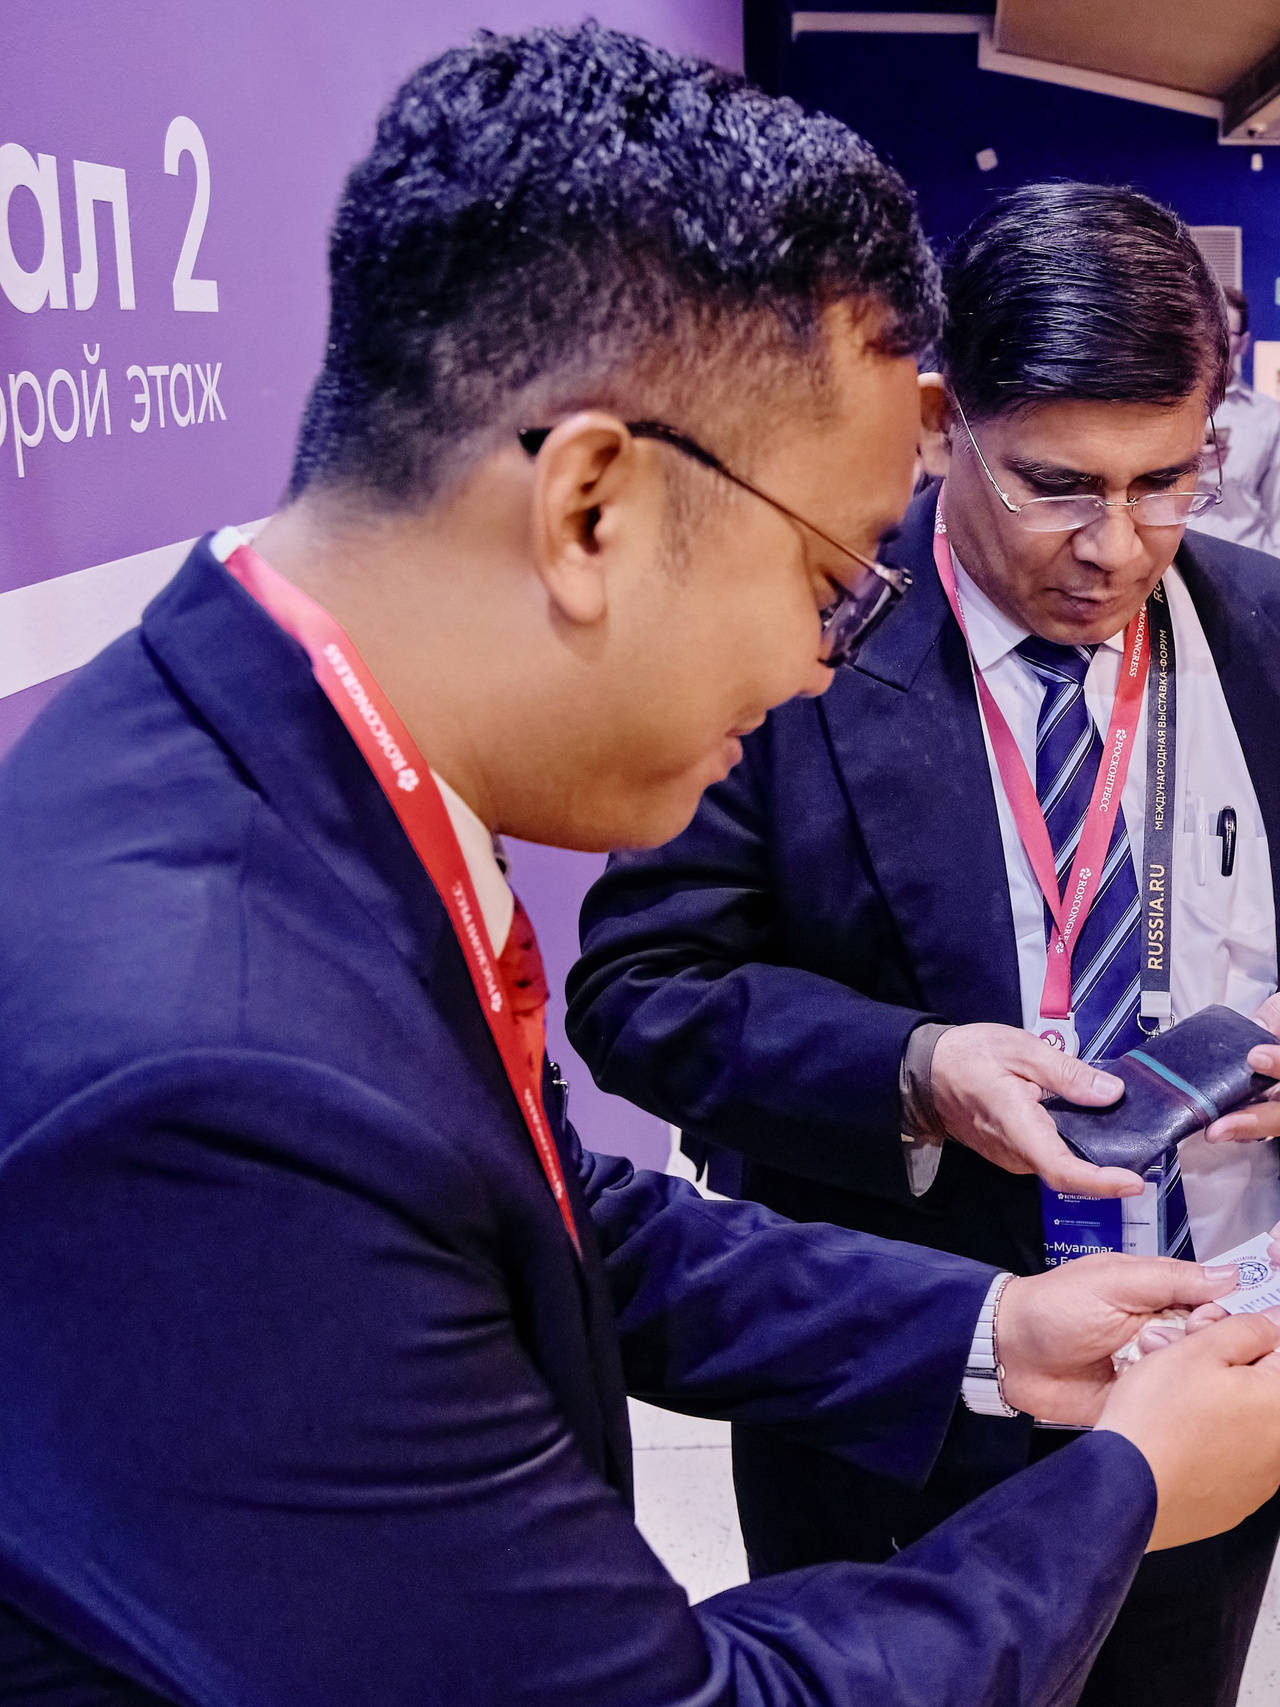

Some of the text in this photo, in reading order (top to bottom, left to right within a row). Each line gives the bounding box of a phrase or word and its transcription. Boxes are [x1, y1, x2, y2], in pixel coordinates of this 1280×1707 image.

[0, 115, 219, 314] ал 2
[126, 362, 227, 433] этаж
[1129, 610, 1146, 678] ROSCONGRESS
[322, 643, 406, 773] ROSCONGRESS
[1155, 629, 1168, 831] МЕЖДУНАРОДНАЯ ВЫСТАВКА-ФОРУМ
[1099, 740, 1127, 813] РОСКОНГРЕСС
[1147, 863, 1166, 970] RUSSIA.RU
